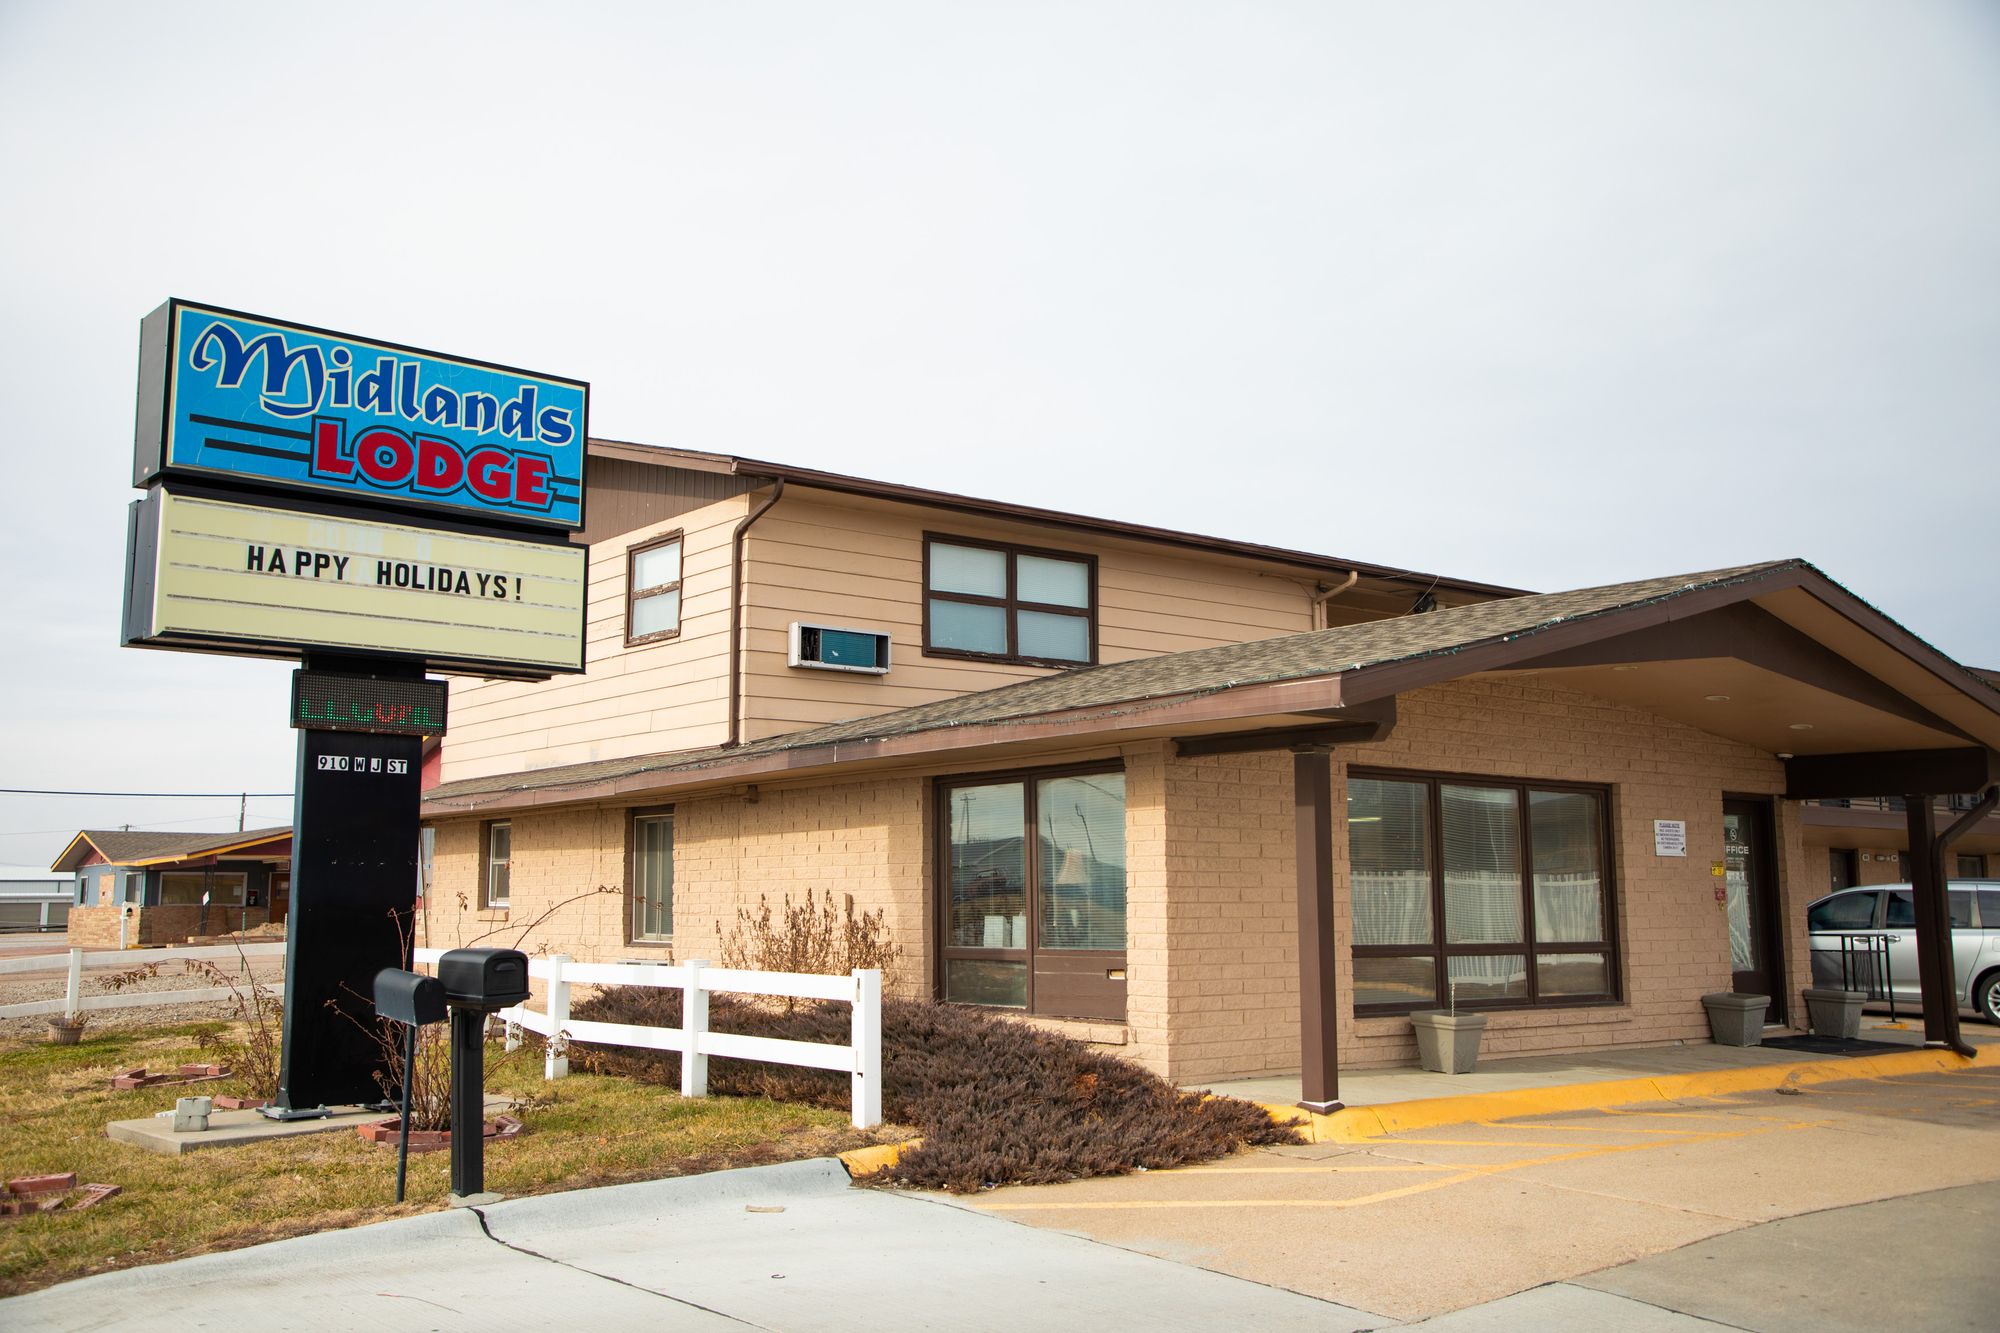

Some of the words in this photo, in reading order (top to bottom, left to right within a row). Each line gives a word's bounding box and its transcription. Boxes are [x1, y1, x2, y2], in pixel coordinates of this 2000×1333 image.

[189, 320, 575, 447] Midlands
[316, 420, 553, 508] LODGE
[247, 545, 350, 580] HAPPY
[377, 561, 522, 600] HOLIDAYS!
[319, 757, 348, 769] 910
[355, 758, 364, 771] W
[372, 759, 380, 772] J
[389, 761, 406, 773] ST
[1724, 845, 1749, 854] FFICE
